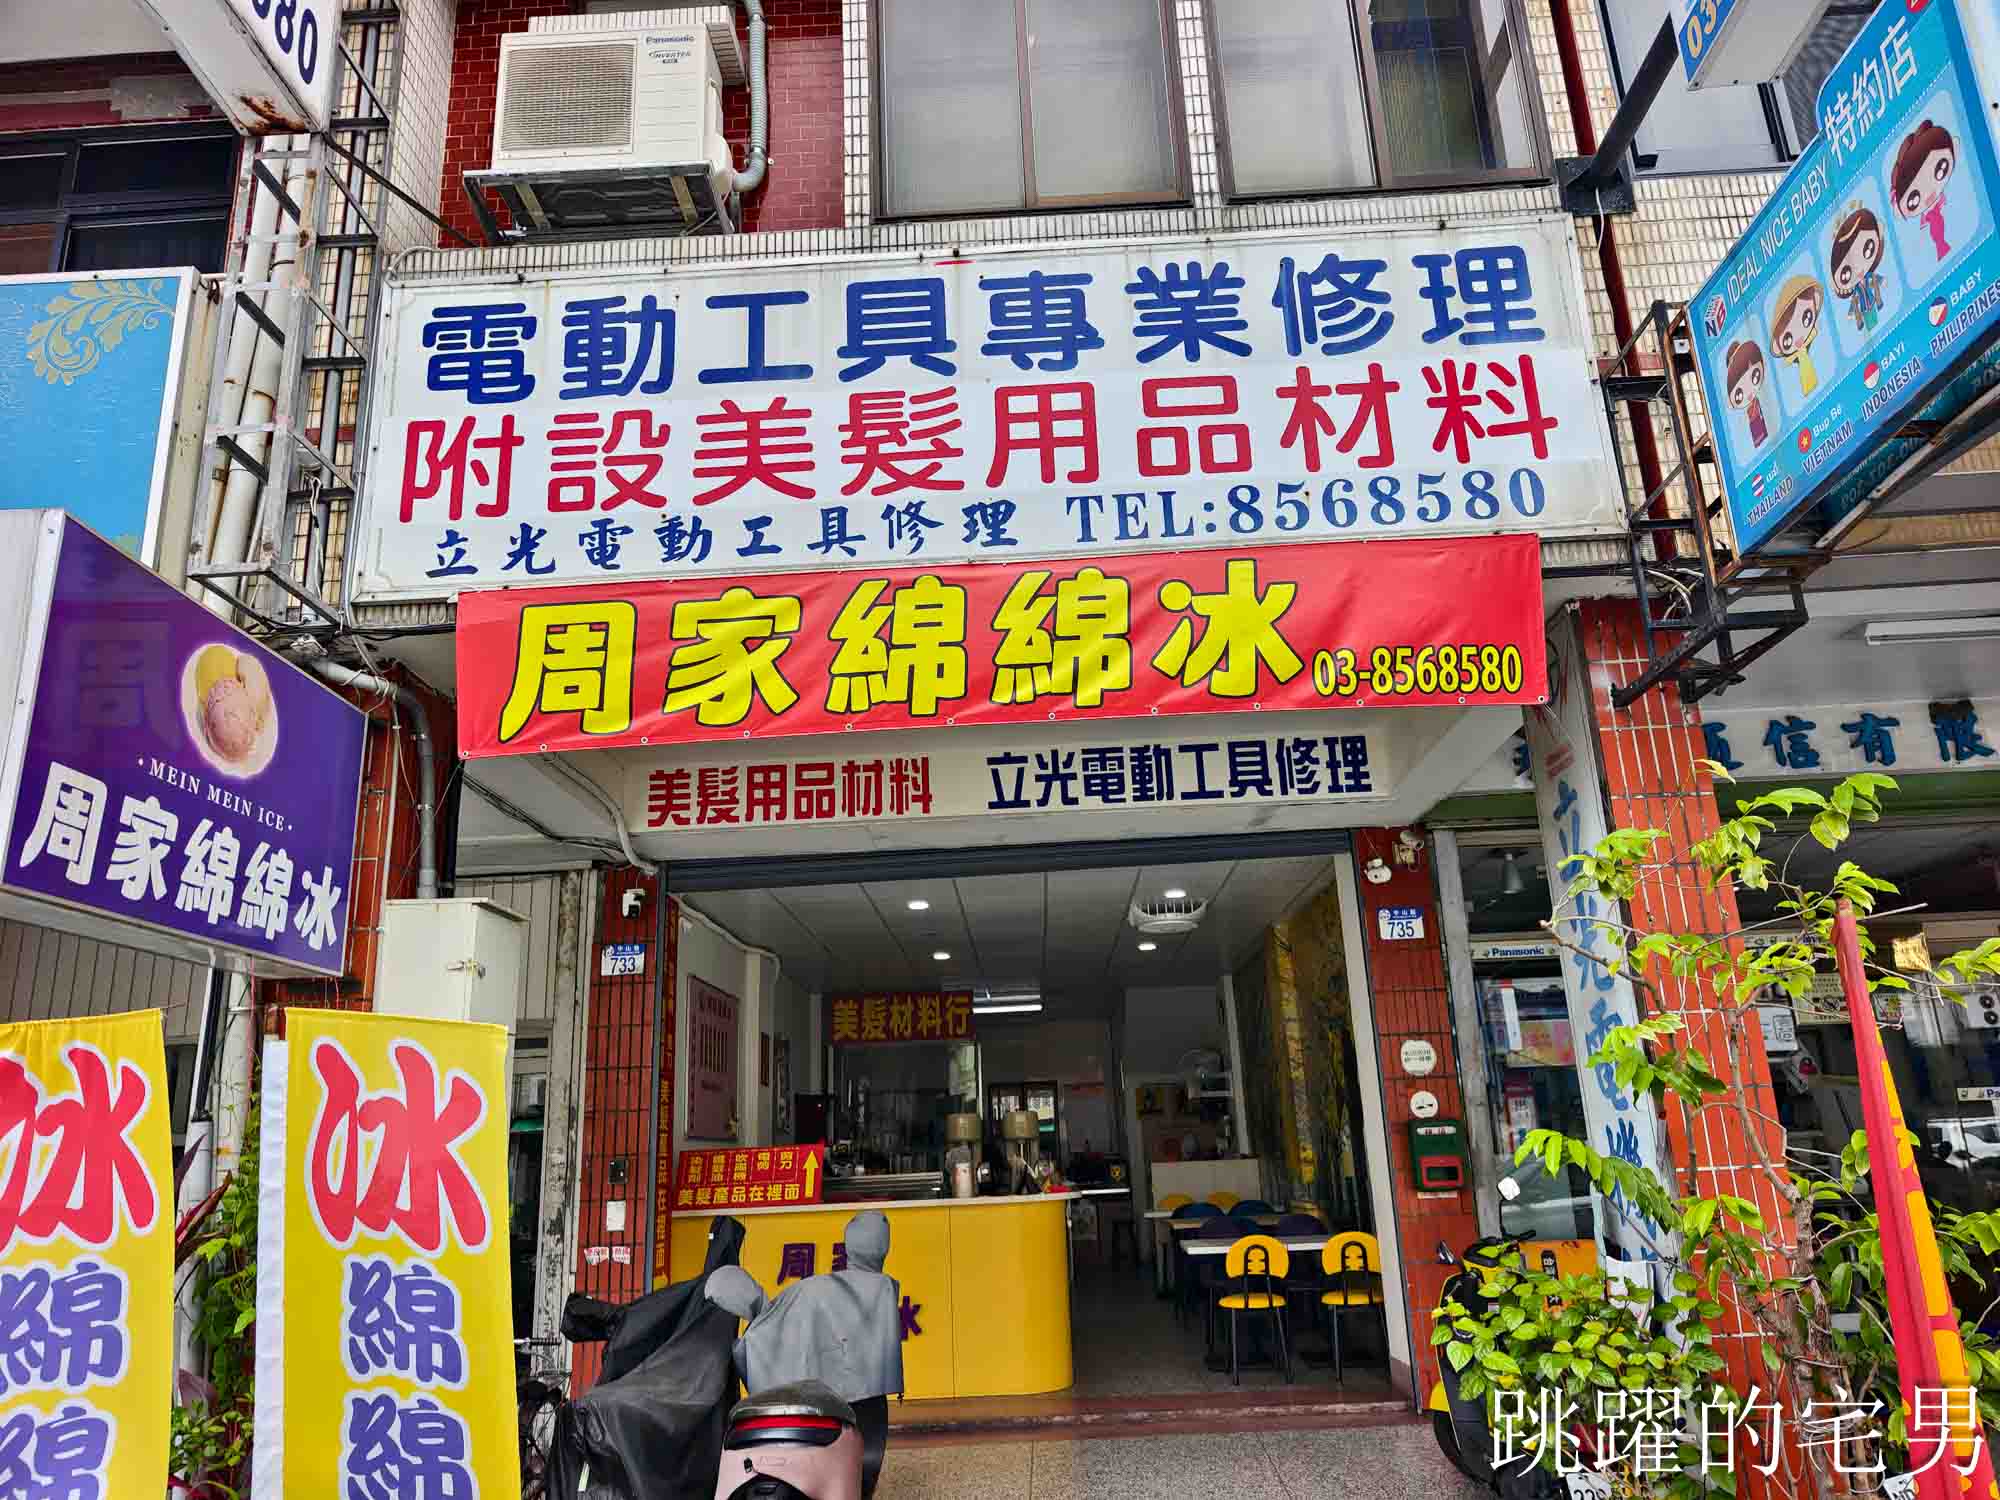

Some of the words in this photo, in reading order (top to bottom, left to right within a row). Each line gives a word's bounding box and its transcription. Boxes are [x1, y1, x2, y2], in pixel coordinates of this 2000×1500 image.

[252, 0, 318, 85] 80
[646, 36, 696, 44] Panasonic
[1824, 15, 1918, 168] 特約店
[1727, 250, 1763, 307] IDEAL
[1759, 207, 1793, 265] NICE
[1790, 158, 1829, 225] BABY
[423, 245, 1546, 405] 電動工具專業修理
[1928, 274, 2000, 359] PHILIPPINES
[1950, 265, 1983, 307] BABY
[1861, 354, 1921, 422] INDONESIA
[399, 354, 1558, 522] 附設美髮用品材料
[1802, 418, 1853, 475] VIETNAM
[425, 499, 1018, 578] 立光電動工具修理
[1066, 467, 1546, 543] TEL:8568580
[1747, 474, 1793, 527] THAILAND
[497, 558, 1305, 744] 周家綿綿冰
[1311, 642, 1524, 698] 03-8568580
[149, 757, 201, 796] MEIN
[207, 782, 254, 818] MEIN
[257, 806, 285, 832] ICE
[647, 756, 933, 828] 美髮用品材料
[986, 734, 1373, 810] 立光電動工具修理
[19, 762, 344, 952] 周家綿綿冰
[610, 956, 636, 974] 733
[1387, 920, 1415, 938] 735
[1491, 946, 1545, 957] Panasonic
[831, 993, 970, 1040] 美髮材料行
[678, 1183, 800, 1206] 美髮產品在裡面
[311, 1040, 488, 1500] 冰綿綿
